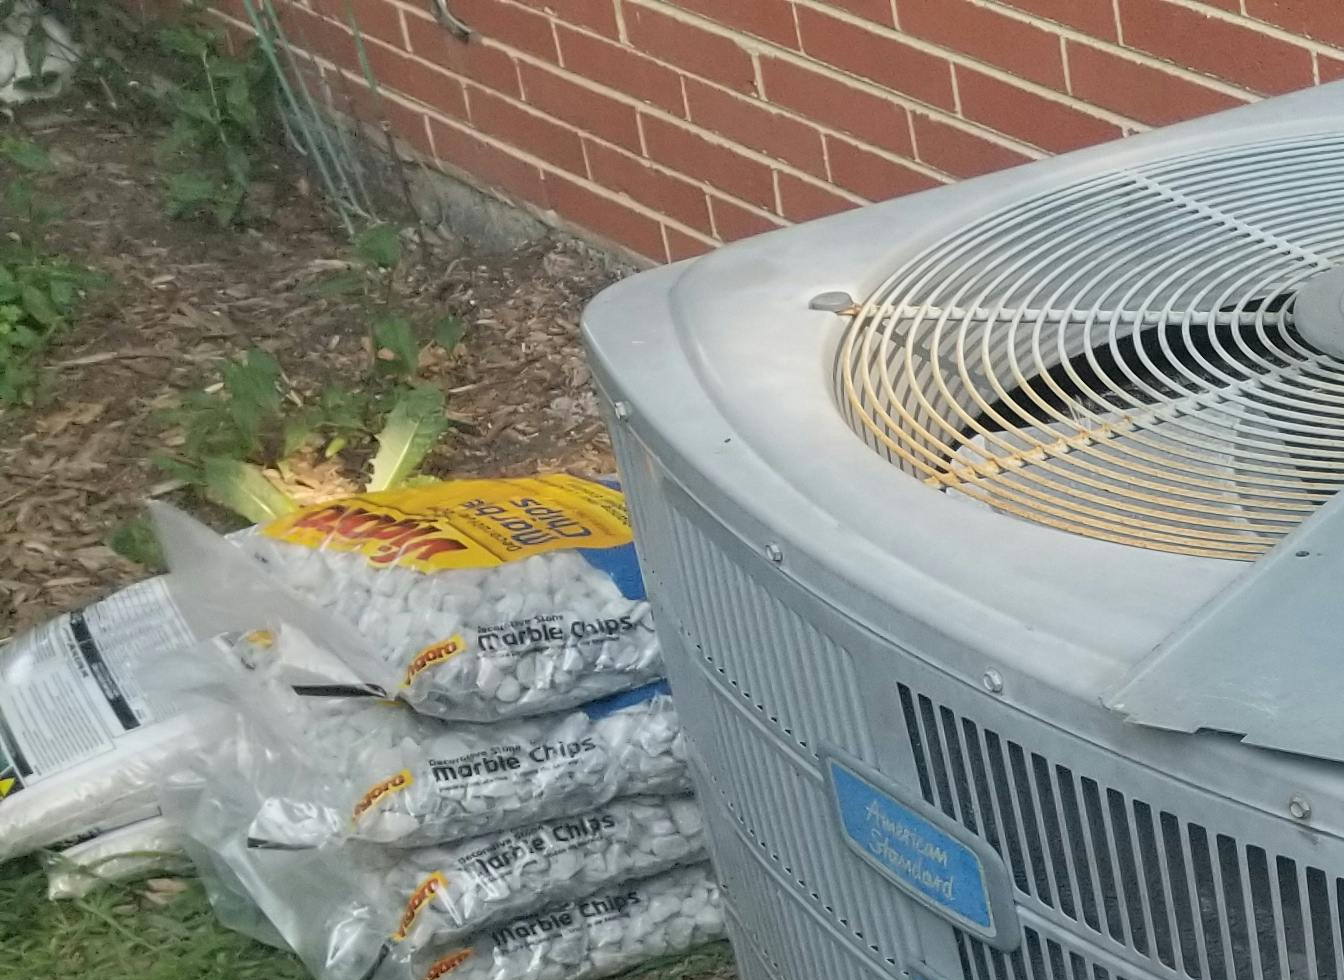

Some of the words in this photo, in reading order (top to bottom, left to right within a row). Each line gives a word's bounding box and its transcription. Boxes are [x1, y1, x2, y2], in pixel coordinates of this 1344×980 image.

[432, 756, 521, 783] Marble
[528, 735, 597, 764] Chips
[864, 799, 949, 868] American
[869, 828, 956, 901] Standard
